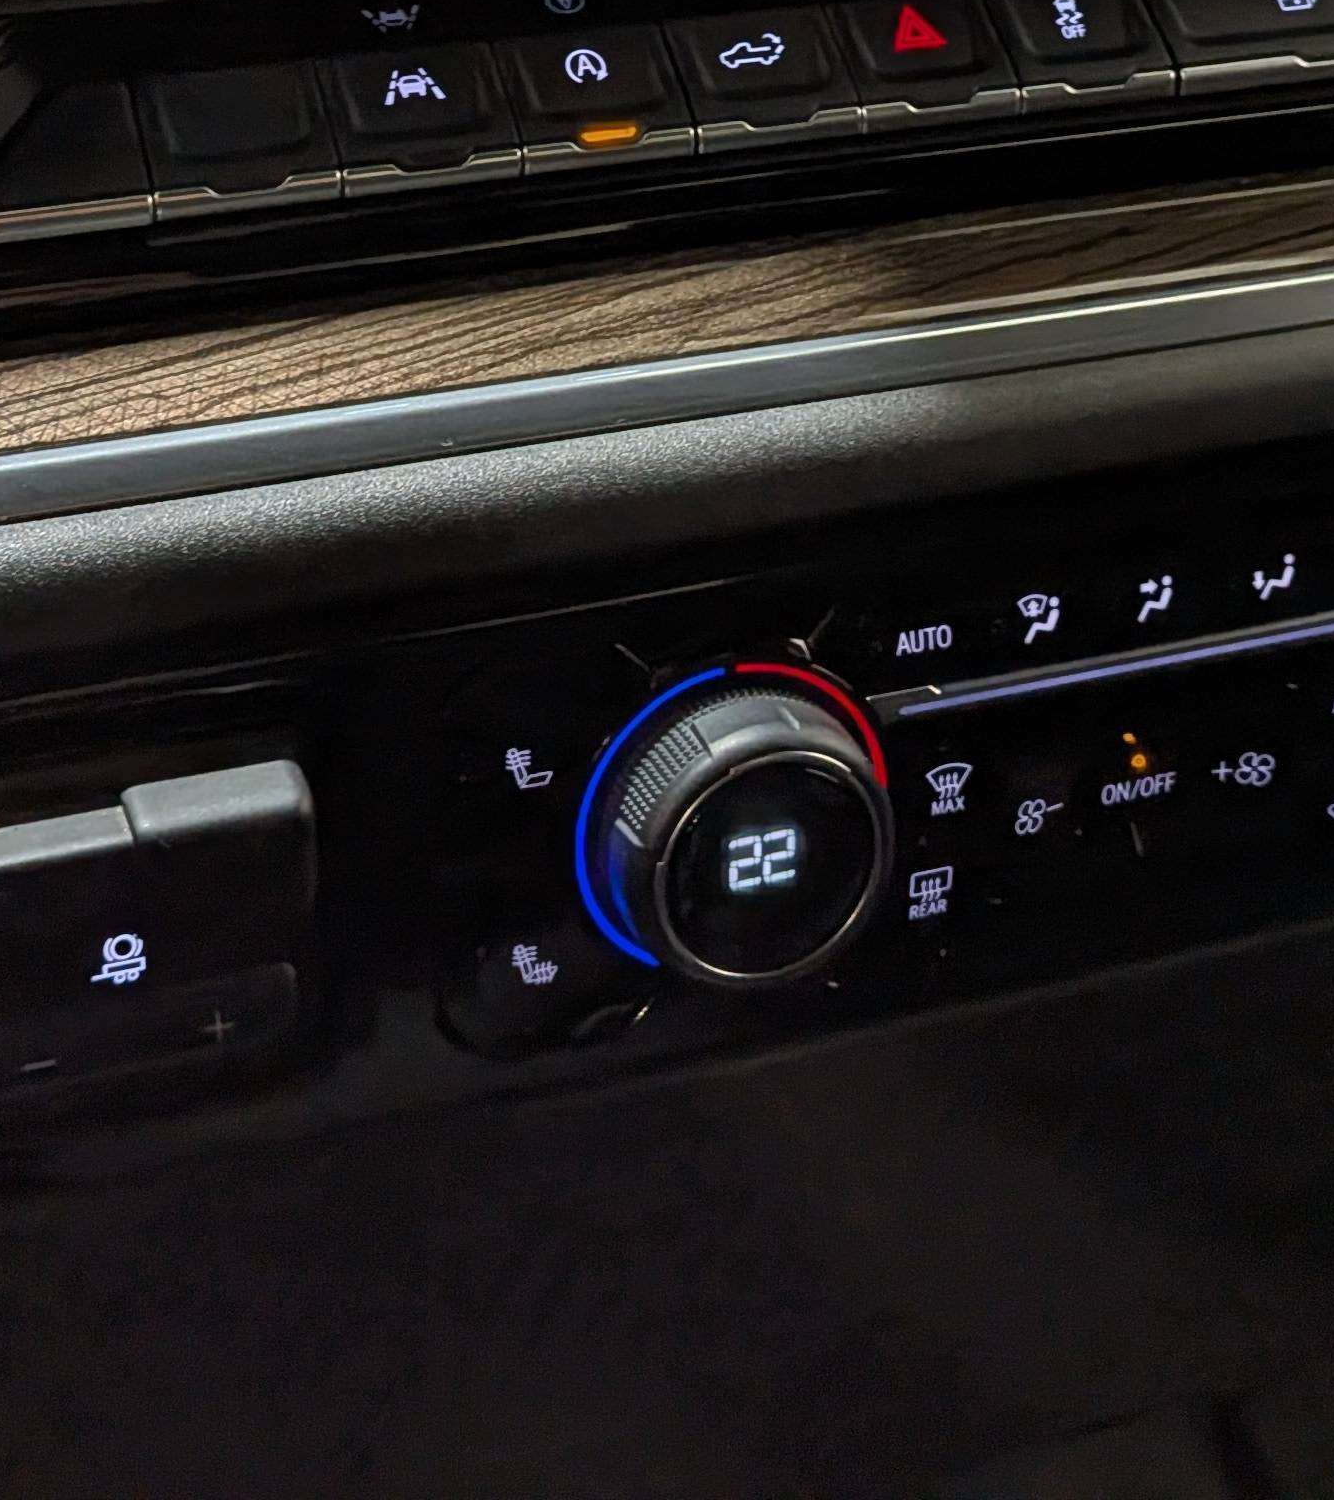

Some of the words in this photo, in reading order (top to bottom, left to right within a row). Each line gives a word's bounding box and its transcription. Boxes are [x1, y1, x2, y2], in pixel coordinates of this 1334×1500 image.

[895, 624, 953, 657] AUTO
[1100, 771, 1177, 806] ON/OFF
[929, 795, 966, 816] MAX
[728, 828, 797, 892] 22
[907, 898, 948, 920] REAR
